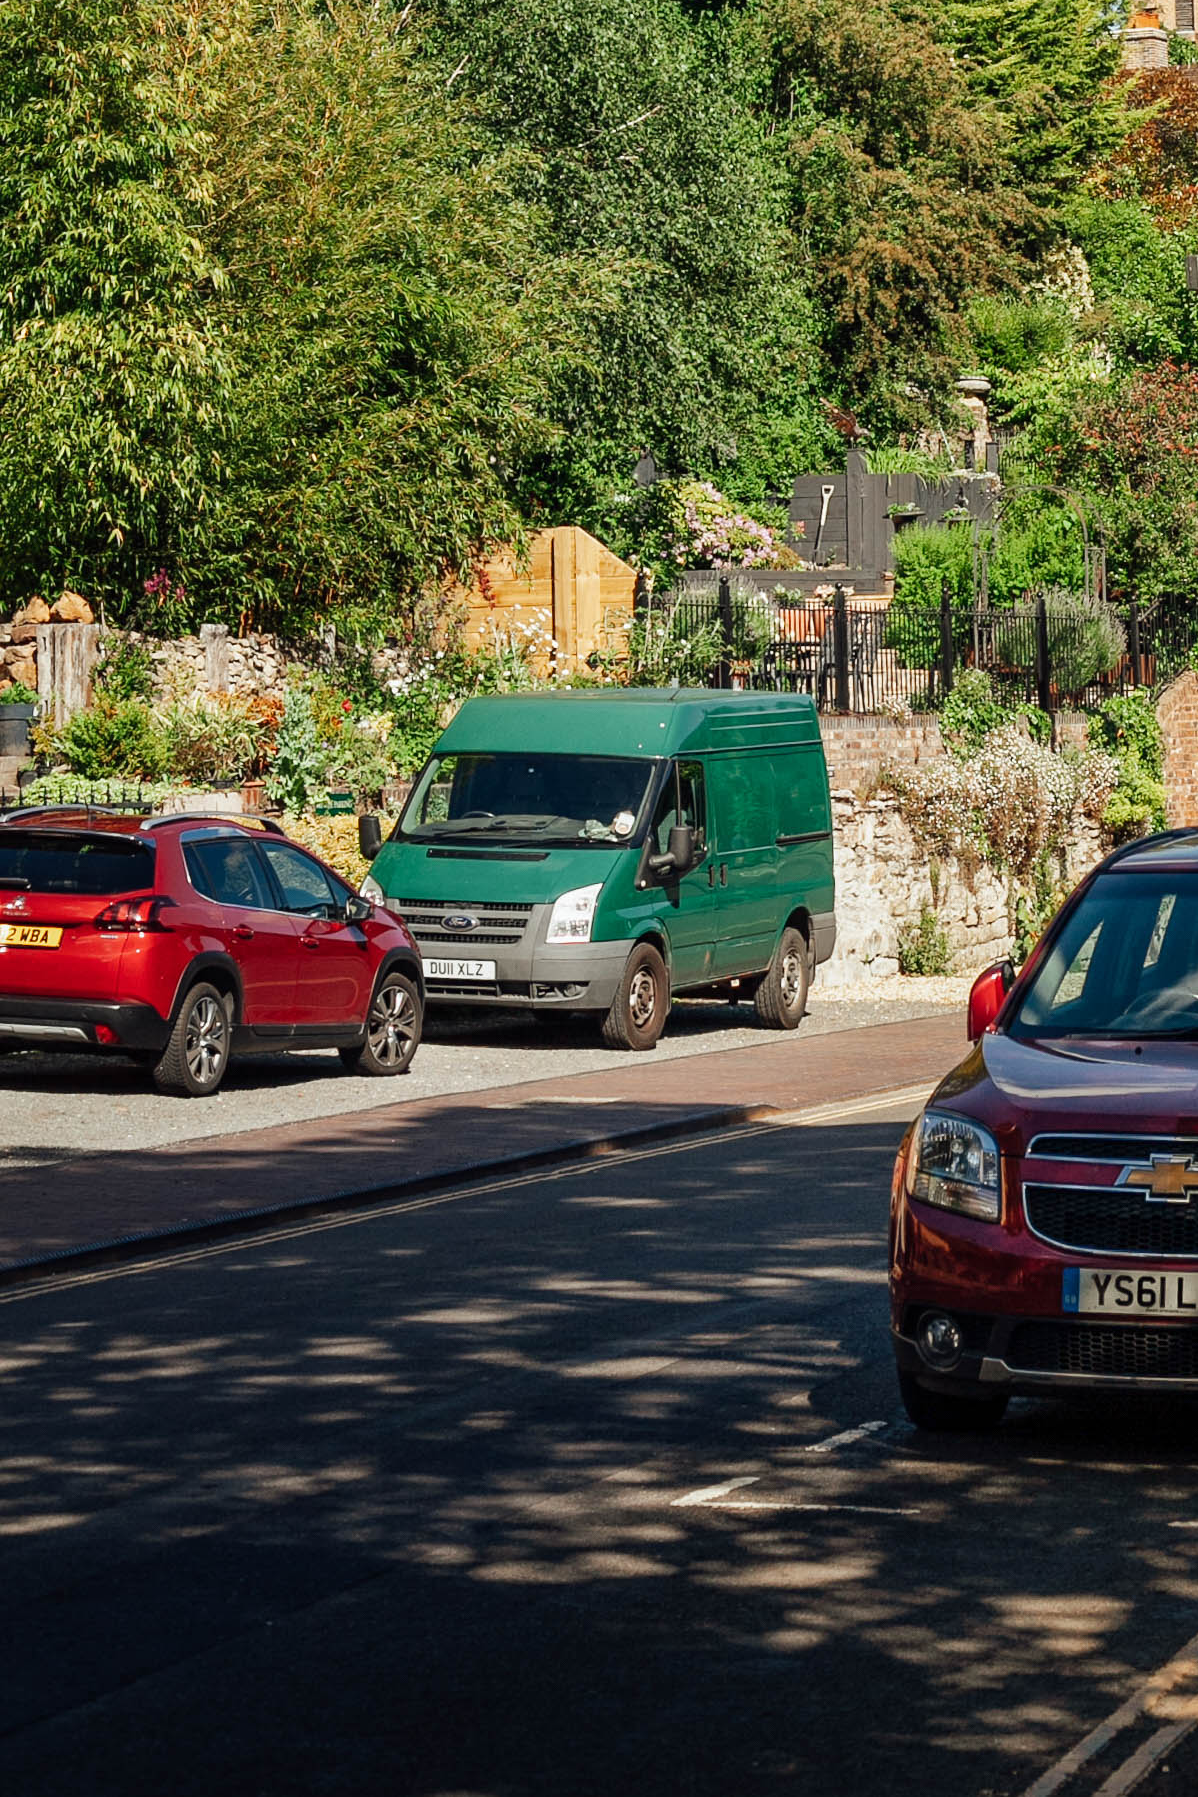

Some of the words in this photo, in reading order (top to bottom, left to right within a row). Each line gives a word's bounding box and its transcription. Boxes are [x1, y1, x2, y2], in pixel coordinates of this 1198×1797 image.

[19, 928, 49, 944] WBA
[430, 961, 454, 976] DU11
[457, 963, 484, 977] XLZ
[1091, 1273, 1167, 1308] YS61
